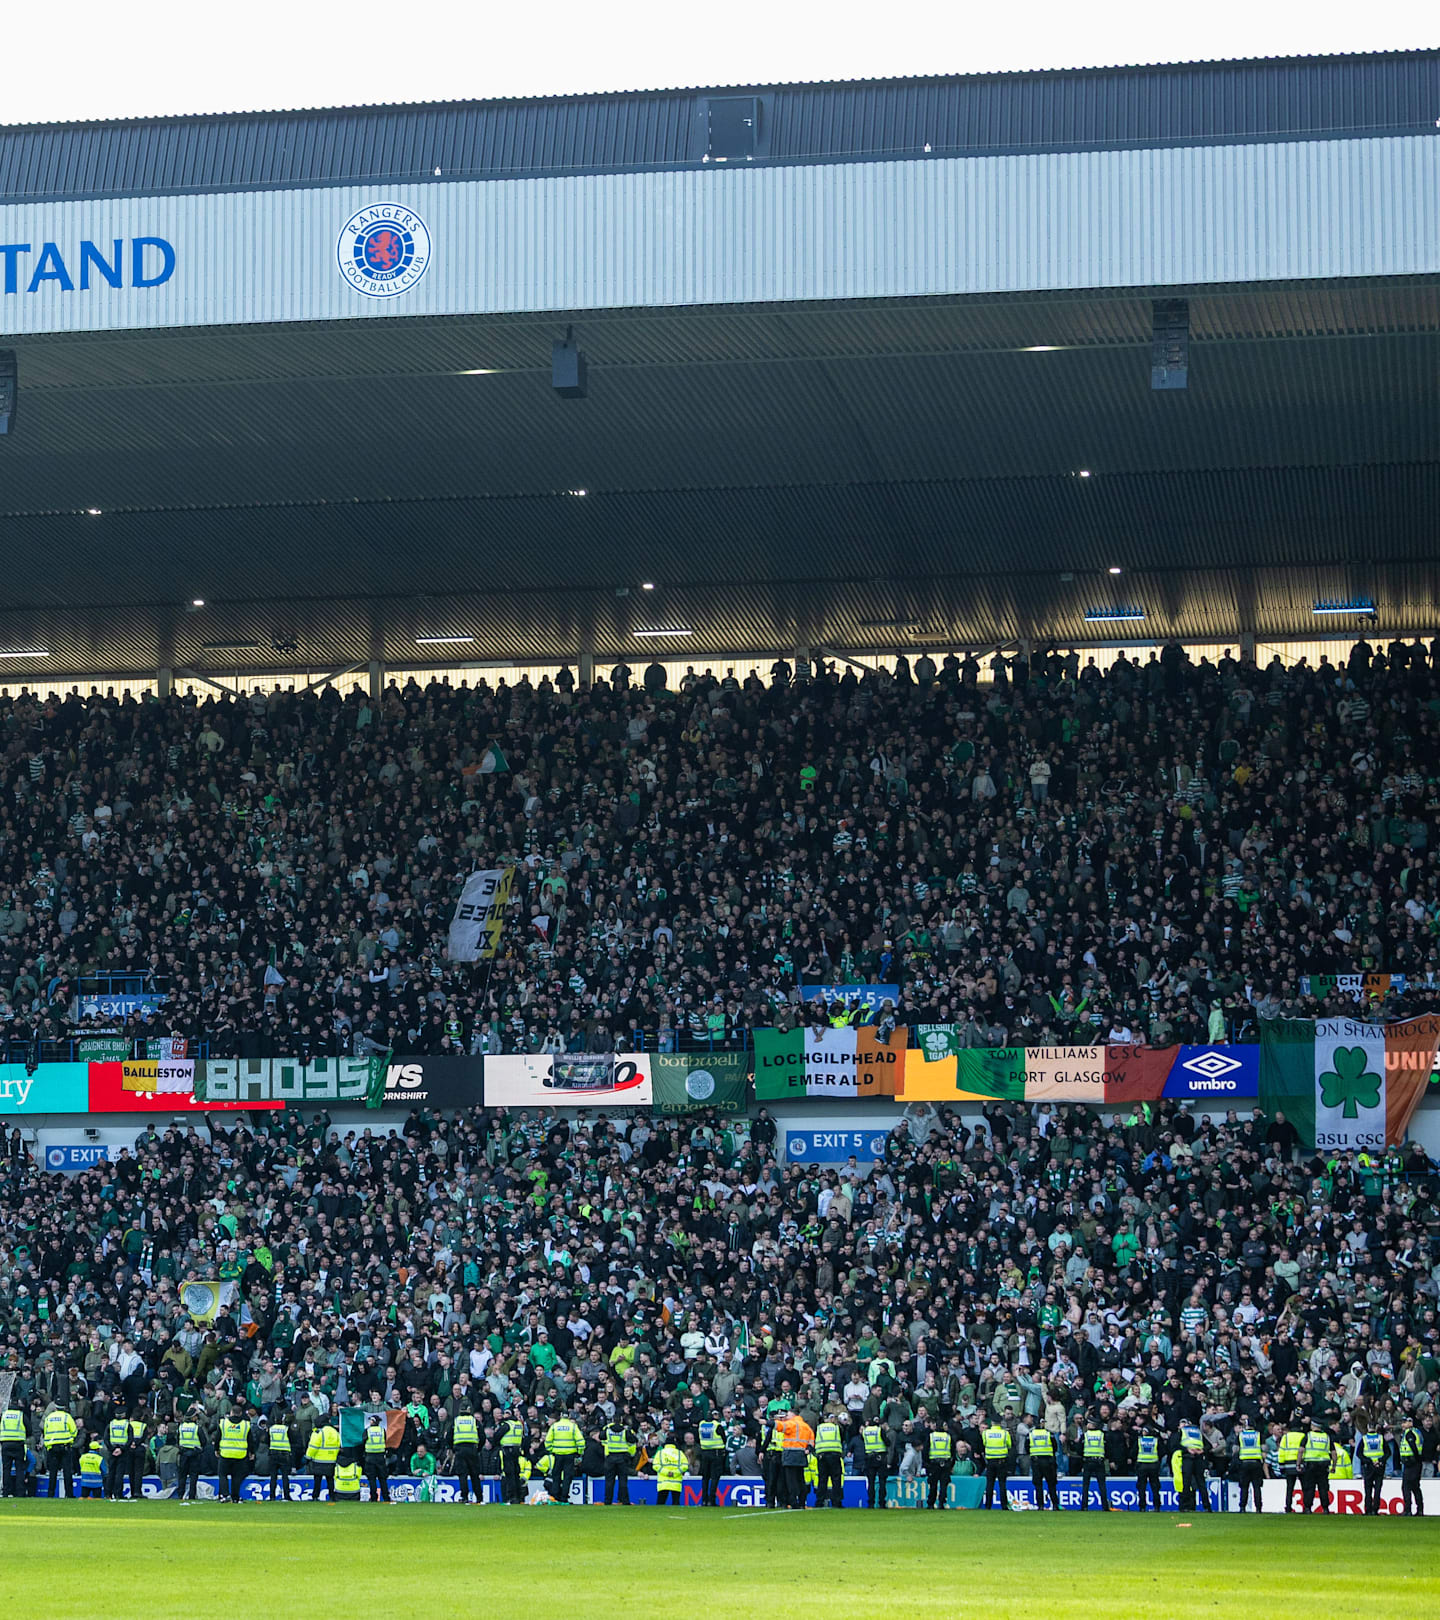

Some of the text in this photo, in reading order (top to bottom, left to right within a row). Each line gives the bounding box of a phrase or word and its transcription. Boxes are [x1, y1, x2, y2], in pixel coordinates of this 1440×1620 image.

[348, 207, 421, 235] RANGERS
[343, 256, 425, 292] FOOTBALL CLUB
[372, 271, 397, 280] READY
[1319, 975, 1381, 986] BUCHAN
[824, 991, 876, 1005] EXIT 5
[101, 1001, 136, 1016] EXIT
[1344, 1019, 1439, 1039] SHAMROCK
[763, 1051, 897, 1067] LOCHGILPHEAD
[989, 1047, 1142, 1060] TOM WILLIAMS CSC
[123, 1066, 192, 1078] BAILLIESTON
[206, 1056, 369, 1099] BHOYS
[1010, 1071, 1127, 1083] PORT GLASGOW
[788, 1073, 874, 1087] EMERALD
[1188, 1078, 1237, 1091] umbro
[813, 1134, 863, 1147] EXIT 5
[1317, 1132, 1384, 1145] asu csc
[70, 1149, 104, 1162] EXIT
[572, 1482, 581, 1496] 5
[684, 1485, 767, 1507] MYGE
